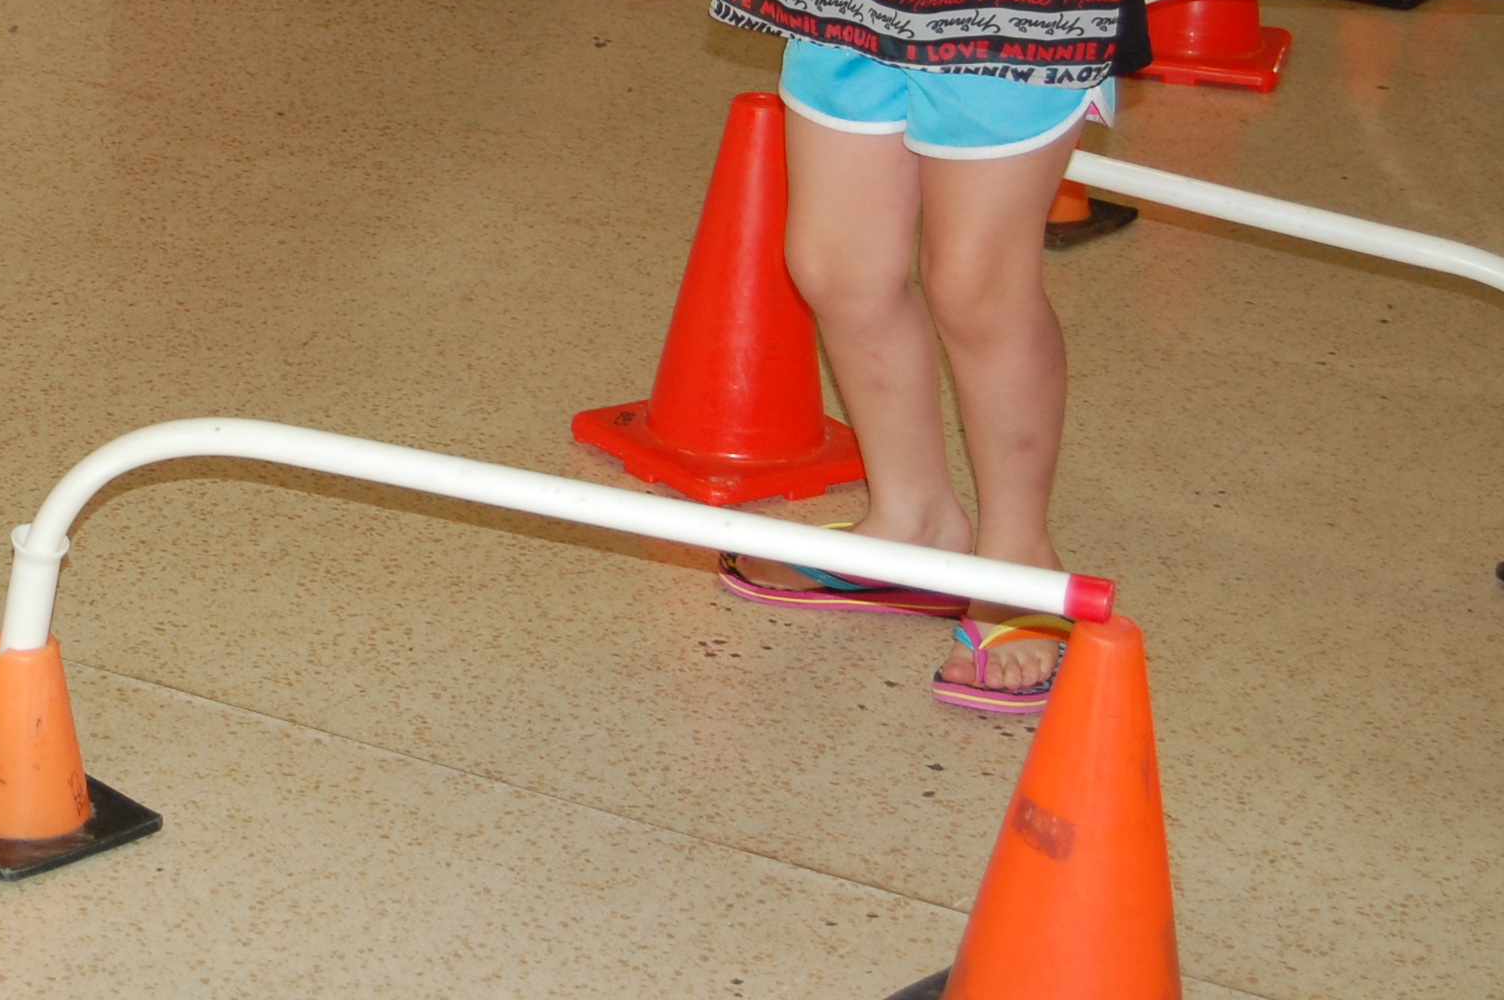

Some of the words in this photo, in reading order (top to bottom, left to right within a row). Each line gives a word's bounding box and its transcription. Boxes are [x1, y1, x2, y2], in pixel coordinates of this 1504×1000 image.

[759, 0, 821, 37] MINNIE
[824, 22, 881, 53] MOUSE
[926, 40, 990, 63] LOVE
[999, 42, 1098, 62] MINNIE
[925, 8, 1002, 35] Minnie
[1007, 12, 1086, 37] Minnie
